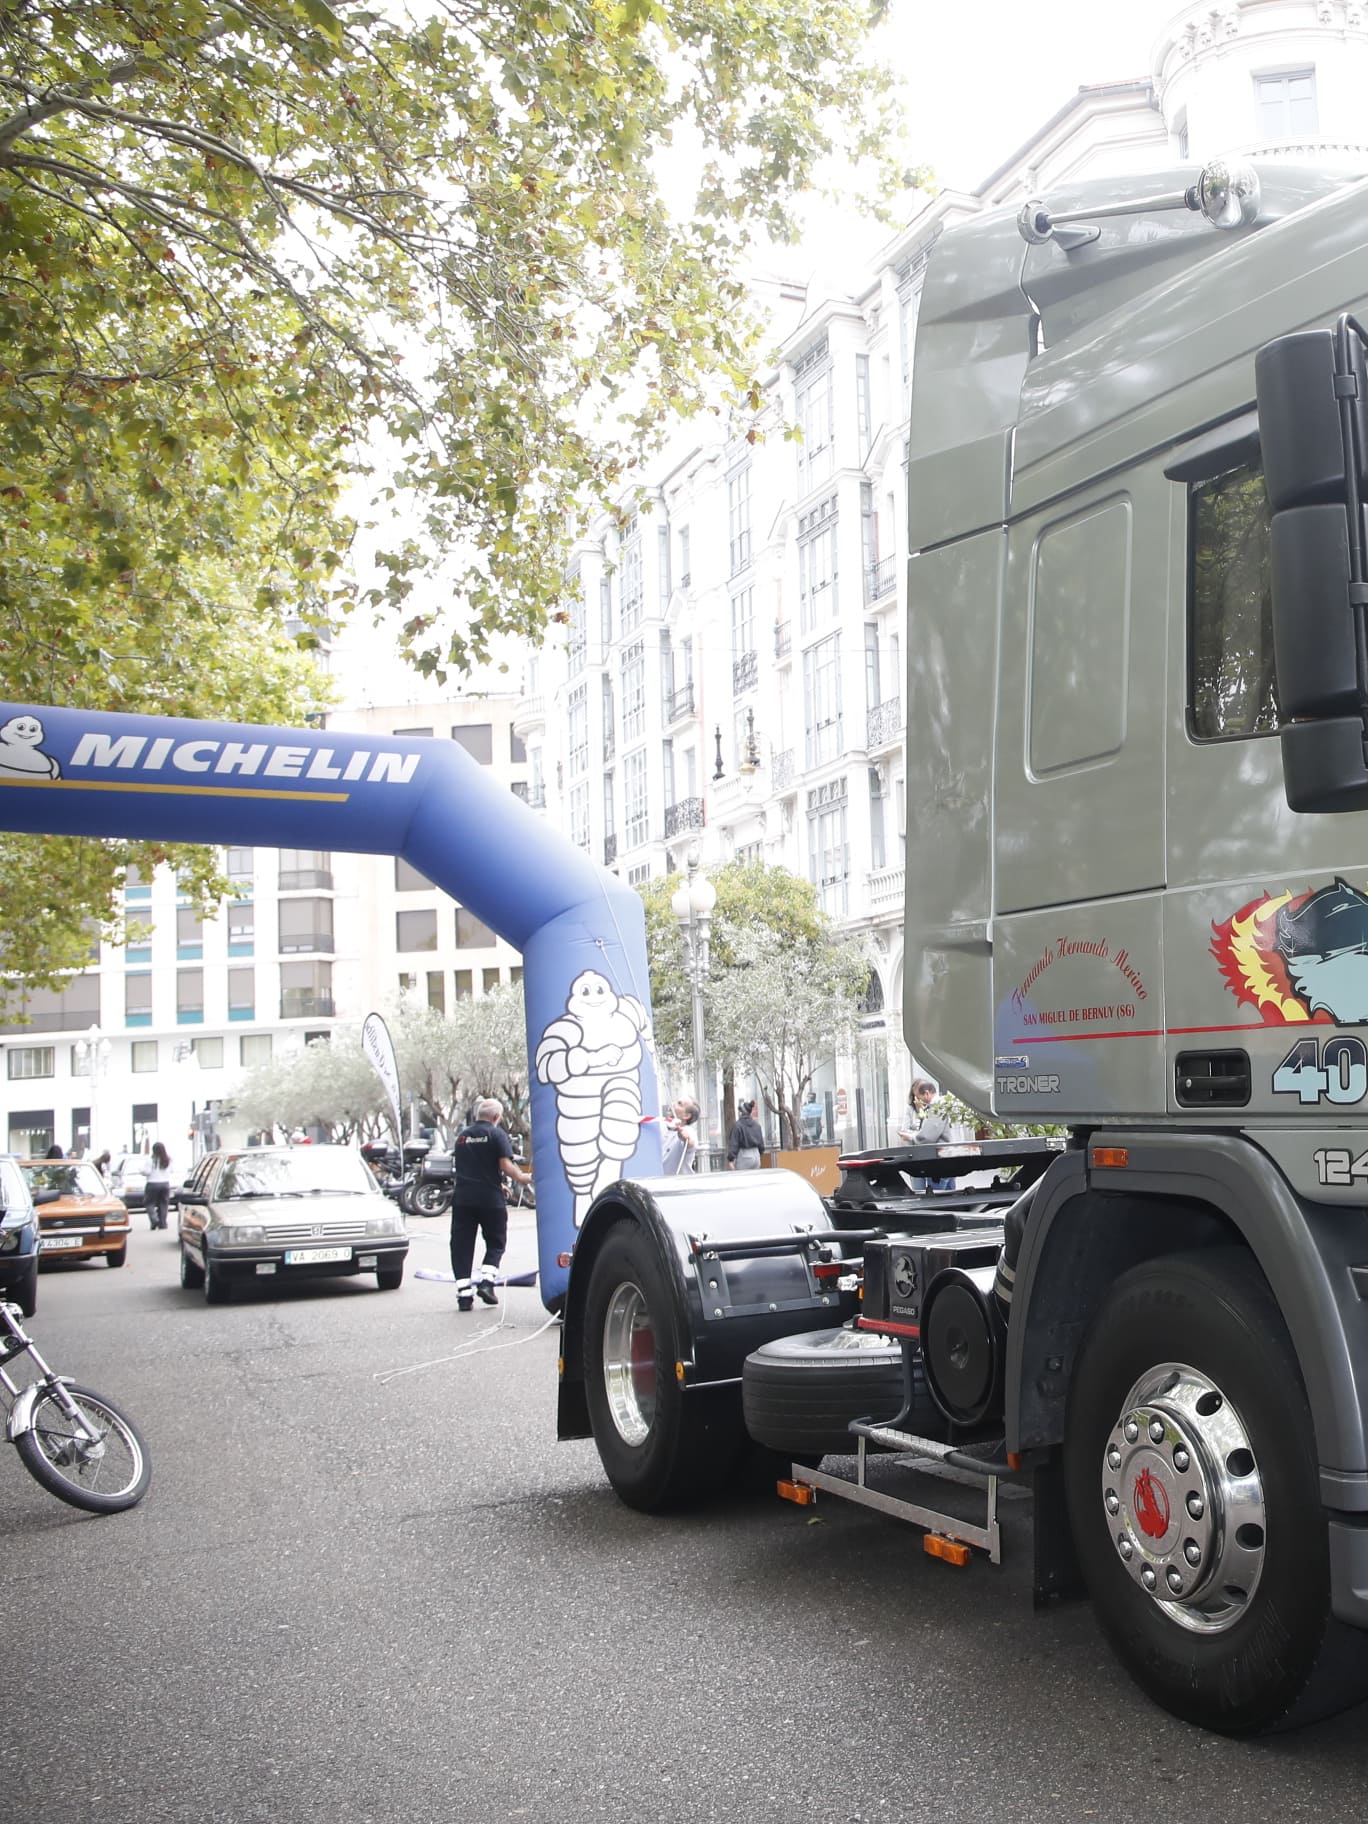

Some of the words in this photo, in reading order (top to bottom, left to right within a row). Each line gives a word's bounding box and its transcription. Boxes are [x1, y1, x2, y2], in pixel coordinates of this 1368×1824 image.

[69, 733, 421, 784] MICHELIN
[1012, 946, 1054, 1015] Fernando
[1056, 936, 1109, 958] Hernando
[1110, 948, 1148, 1001] Merino
[1023, 1014, 1037, 1026] SAN
[1039, 1011, 1067, 1024] MIGUEL
[1069, 1009, 1080, 1021] DE
[1082, 1006, 1115, 1020] BERNUY
[1116, 1003, 1135, 1020] (SG)
[997, 1074, 1061, 1094] TRONER
[292, 1251, 305, 1262] VA
[312, 1249, 338, 1261] 2069
